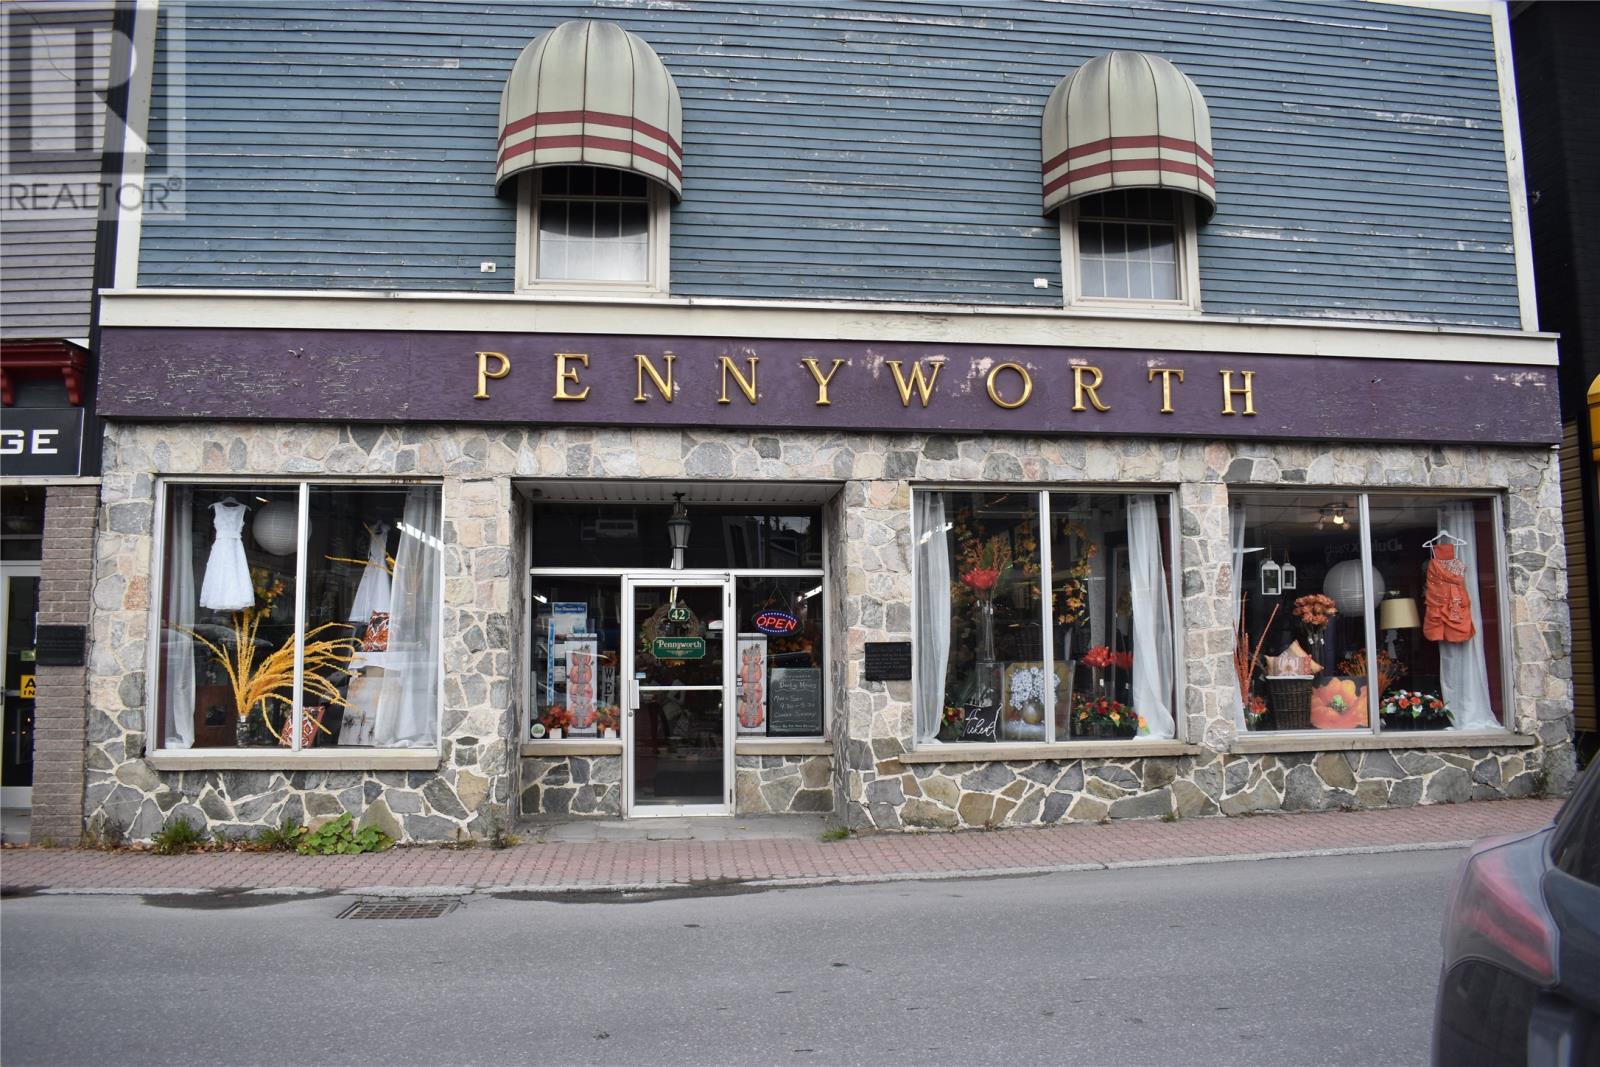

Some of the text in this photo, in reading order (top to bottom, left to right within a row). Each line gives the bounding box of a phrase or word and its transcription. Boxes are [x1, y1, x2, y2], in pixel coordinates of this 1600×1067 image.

[473, 351, 1257, 416] PENNYWORTH
[671, 609, 686, 620] 42
[756, 615, 798, 630] OPEN
[656, 640, 702, 650] Pennyworth
